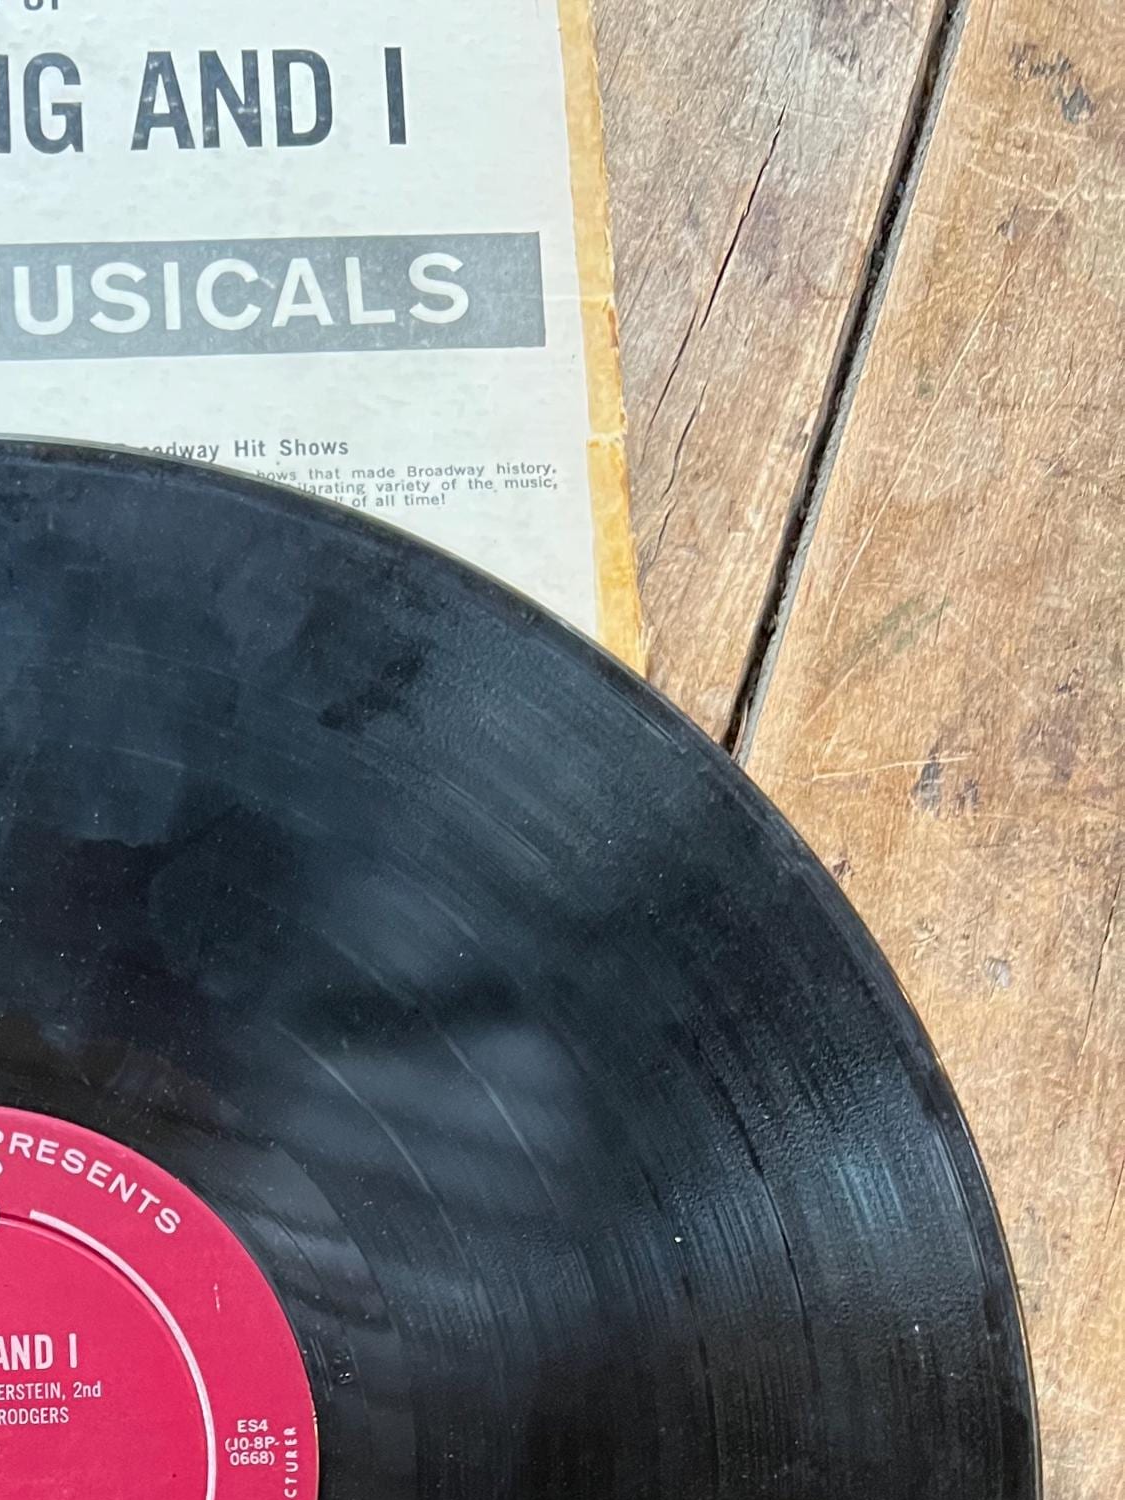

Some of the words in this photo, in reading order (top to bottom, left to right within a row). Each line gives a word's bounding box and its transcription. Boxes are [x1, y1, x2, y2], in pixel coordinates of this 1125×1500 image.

[130, 47, 332, 152] AND
[384, 46, 408, 146] I
[234, 439, 266, 457] Hit
[279, 438, 349, 457] Shows
[254, 469, 296, 482] hows
[308, 467, 340, 480] that
[351, 466, 395, 479] made
[407, 464, 485, 478] Broadway
[496, 462, 557, 476] history.
[375, 478, 430, 493] variety
[441, 478, 457, 491] of
[468, 478, 493, 490] the
[504, 475, 558, 490] music,
[351, 495, 367, 508] of
[375, 495, 394, 507] all
[404, 493, 445, 506] time!
[68, 1332, 78, 1369] I
[73, 1380, 102, 1398] 2nd
[237, 1418, 269, 1433] ES4
[229, 1450, 275, 1466] 0668)
